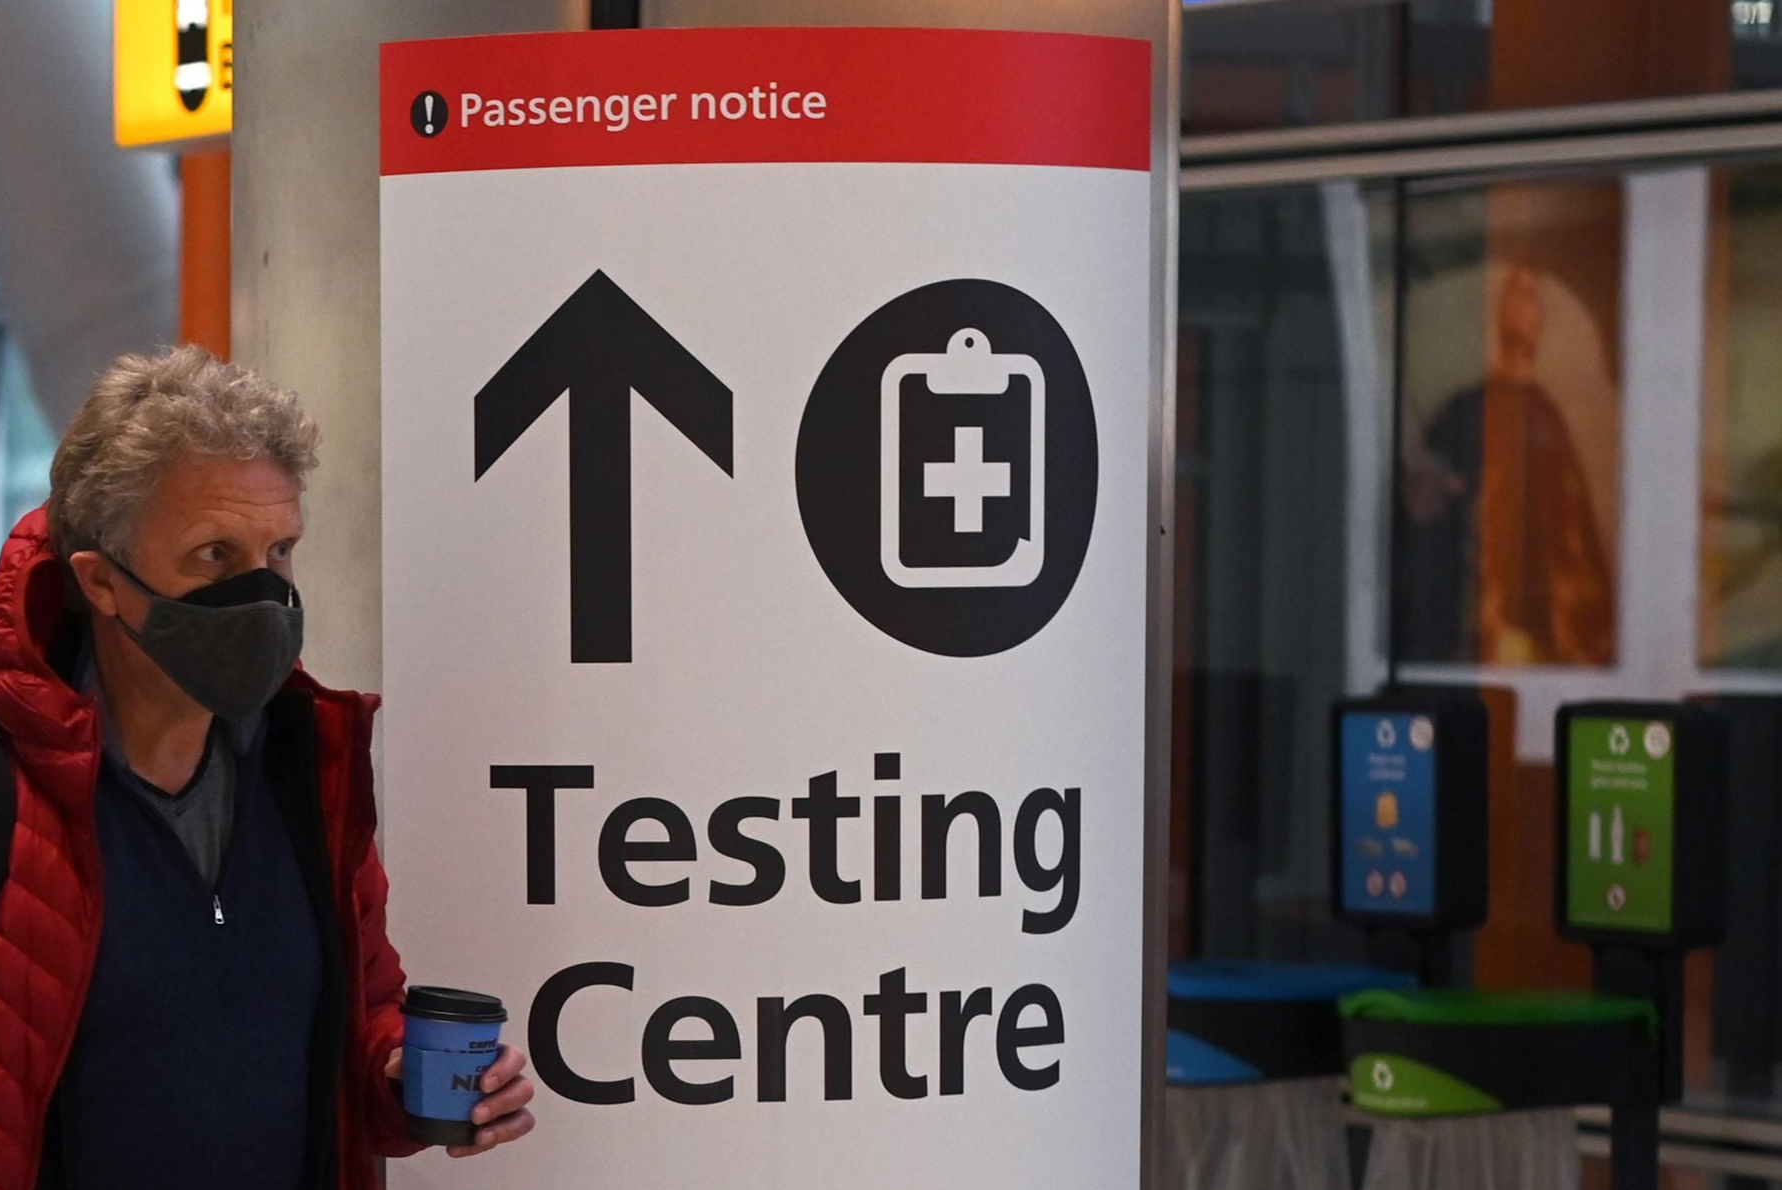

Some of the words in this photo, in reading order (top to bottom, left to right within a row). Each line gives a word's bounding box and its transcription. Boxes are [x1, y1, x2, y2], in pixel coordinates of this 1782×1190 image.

[460, 93, 678, 132] Passenger
[691, 82, 827, 120] notice
[489, 752, 1082, 935] Testing
[526, 961, 1065, 1105] Centre
